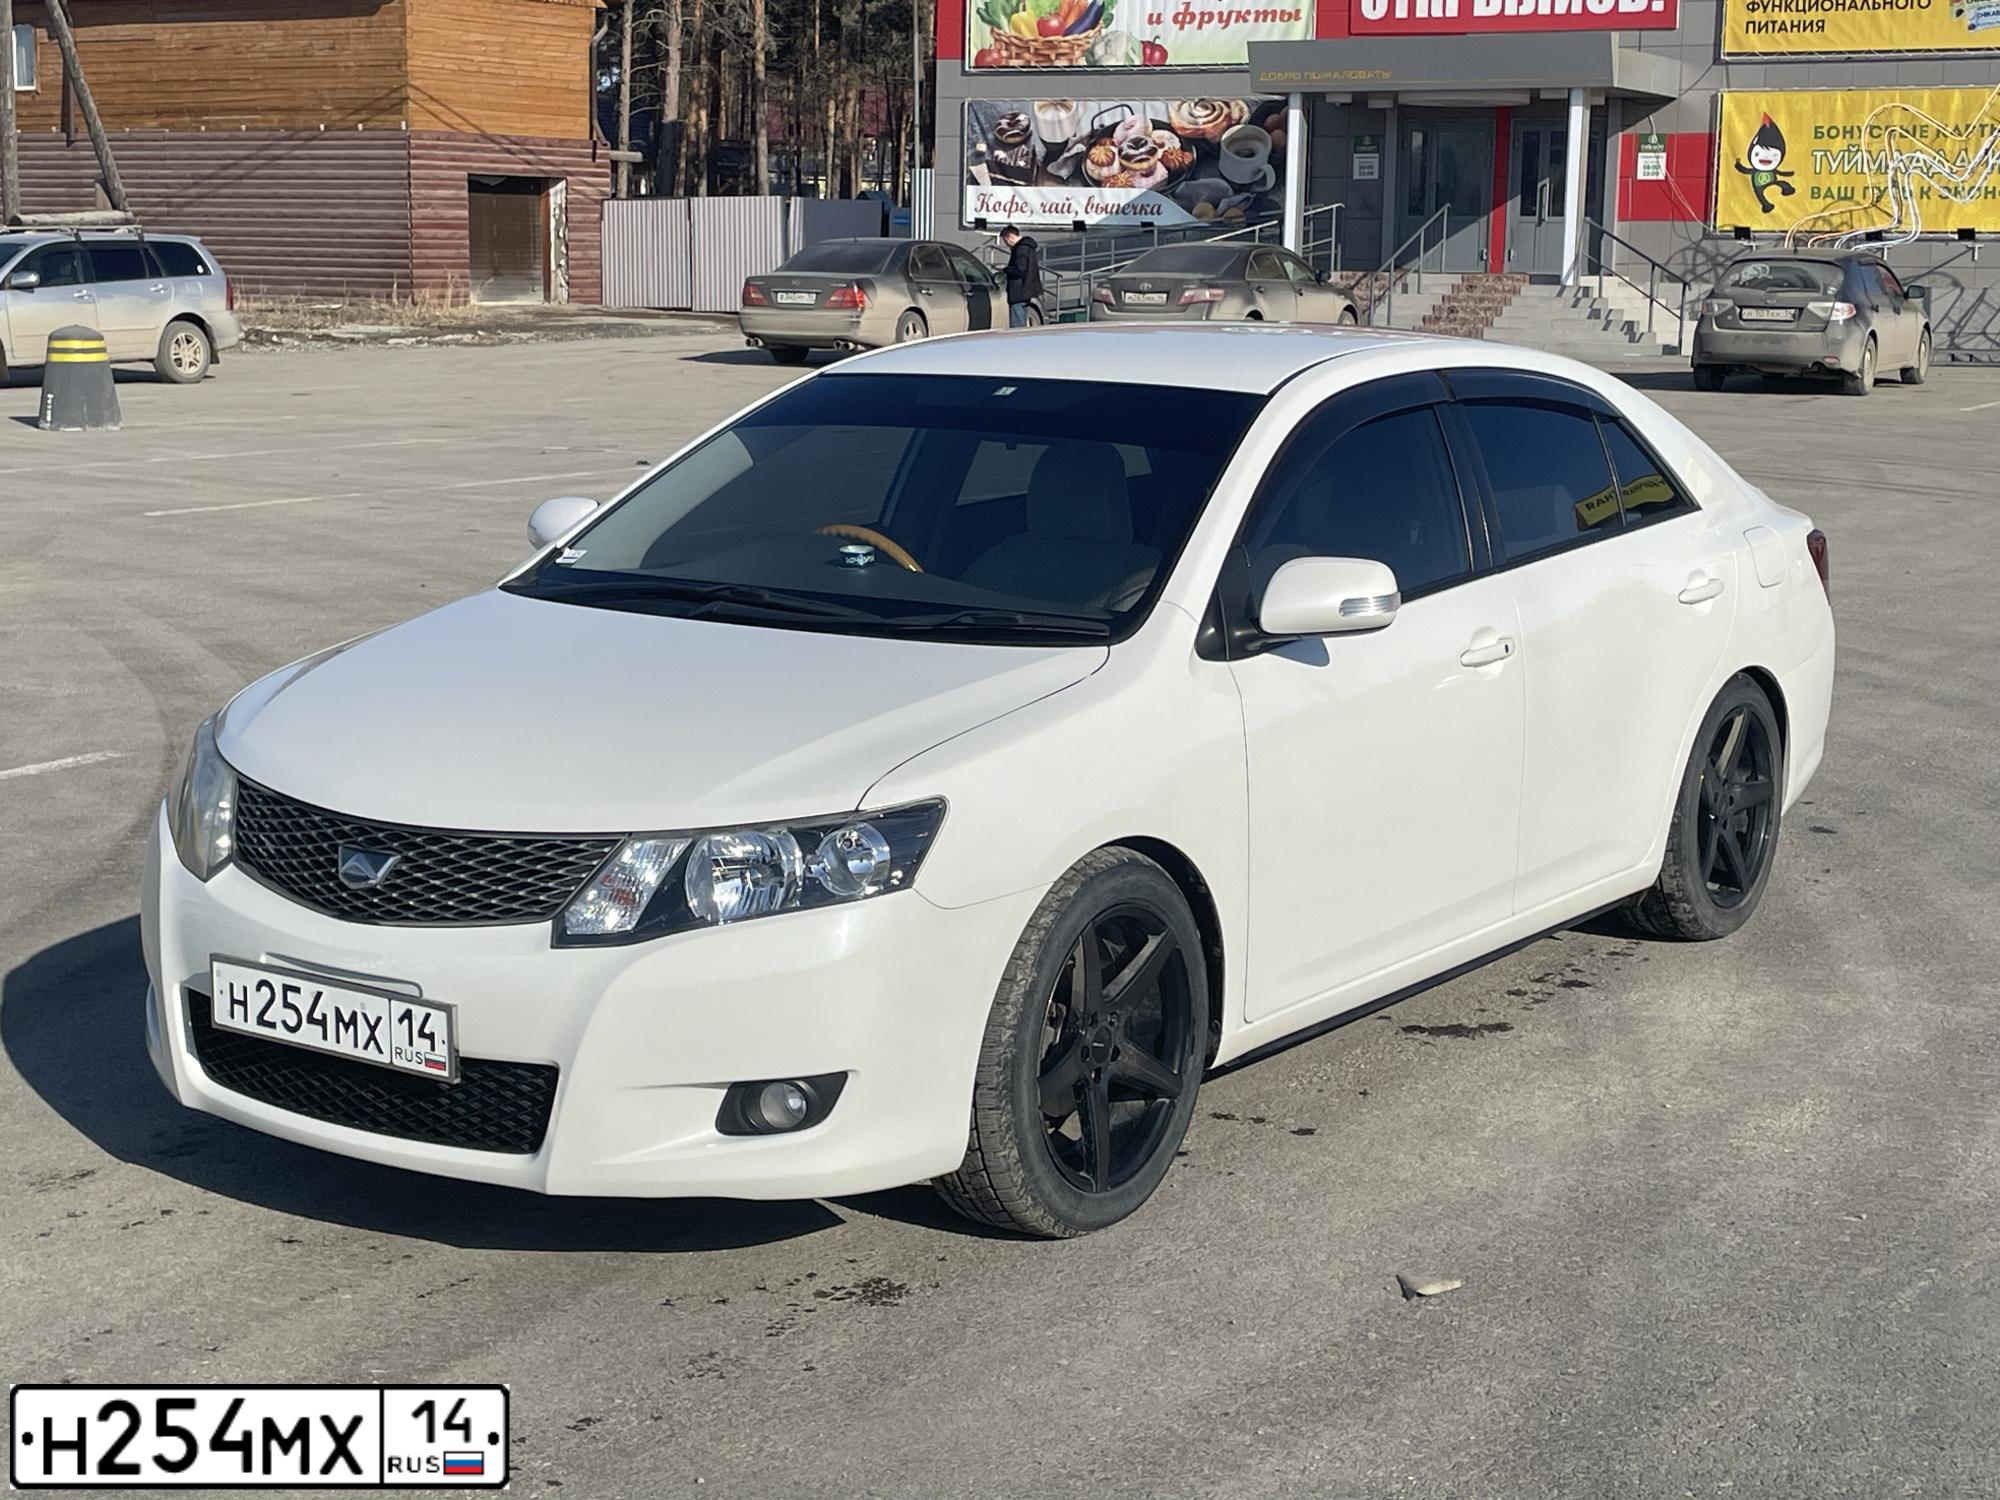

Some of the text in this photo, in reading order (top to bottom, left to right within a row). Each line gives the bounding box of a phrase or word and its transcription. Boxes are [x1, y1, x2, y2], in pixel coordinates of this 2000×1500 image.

[1746, 0, 1932, 14] ФУНКЦИОНАЛЬНОГО
[1147, 2, 1303, 30] и фрукты
[1745, 19, 1825, 34] ПИТАНИЯ
[1259, 71, 1301, 81] ДОБРО
[1810, 186, 1855, 200] ВАШ
[1919, 186, 1931, 200] К
[974, 193, 1163, 218] Кофе, чай, выпечка
[228, 979, 436, 1055] Н254МХ 14
[394, 1046, 424, 1065] RUS
